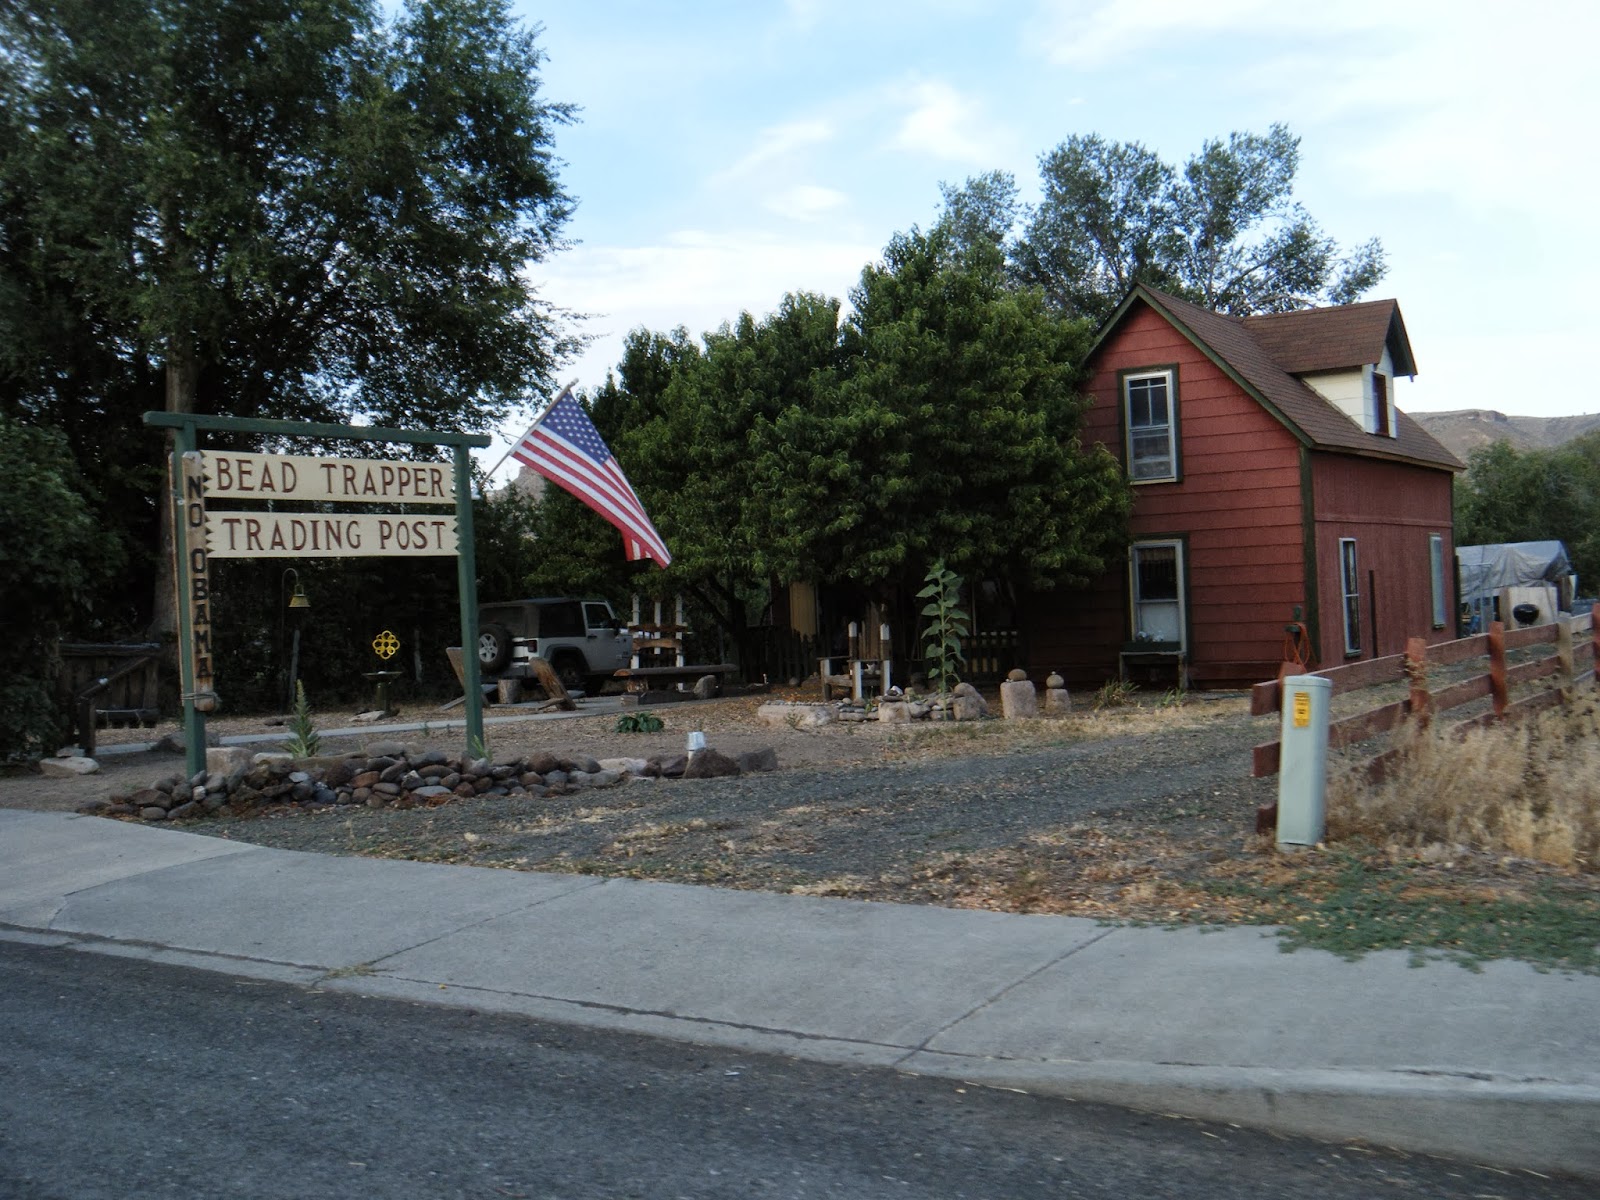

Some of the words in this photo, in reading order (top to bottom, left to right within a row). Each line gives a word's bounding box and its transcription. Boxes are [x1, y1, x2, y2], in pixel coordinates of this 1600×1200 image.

[216, 457, 297, 493] BEAD
[320, 463, 445, 497] TRAPPER
[188, 475, 202, 528] NO
[221, 518, 361, 551] TRADING
[379, 520, 446, 550] POST
[191, 548, 211, 679] OBAMA
